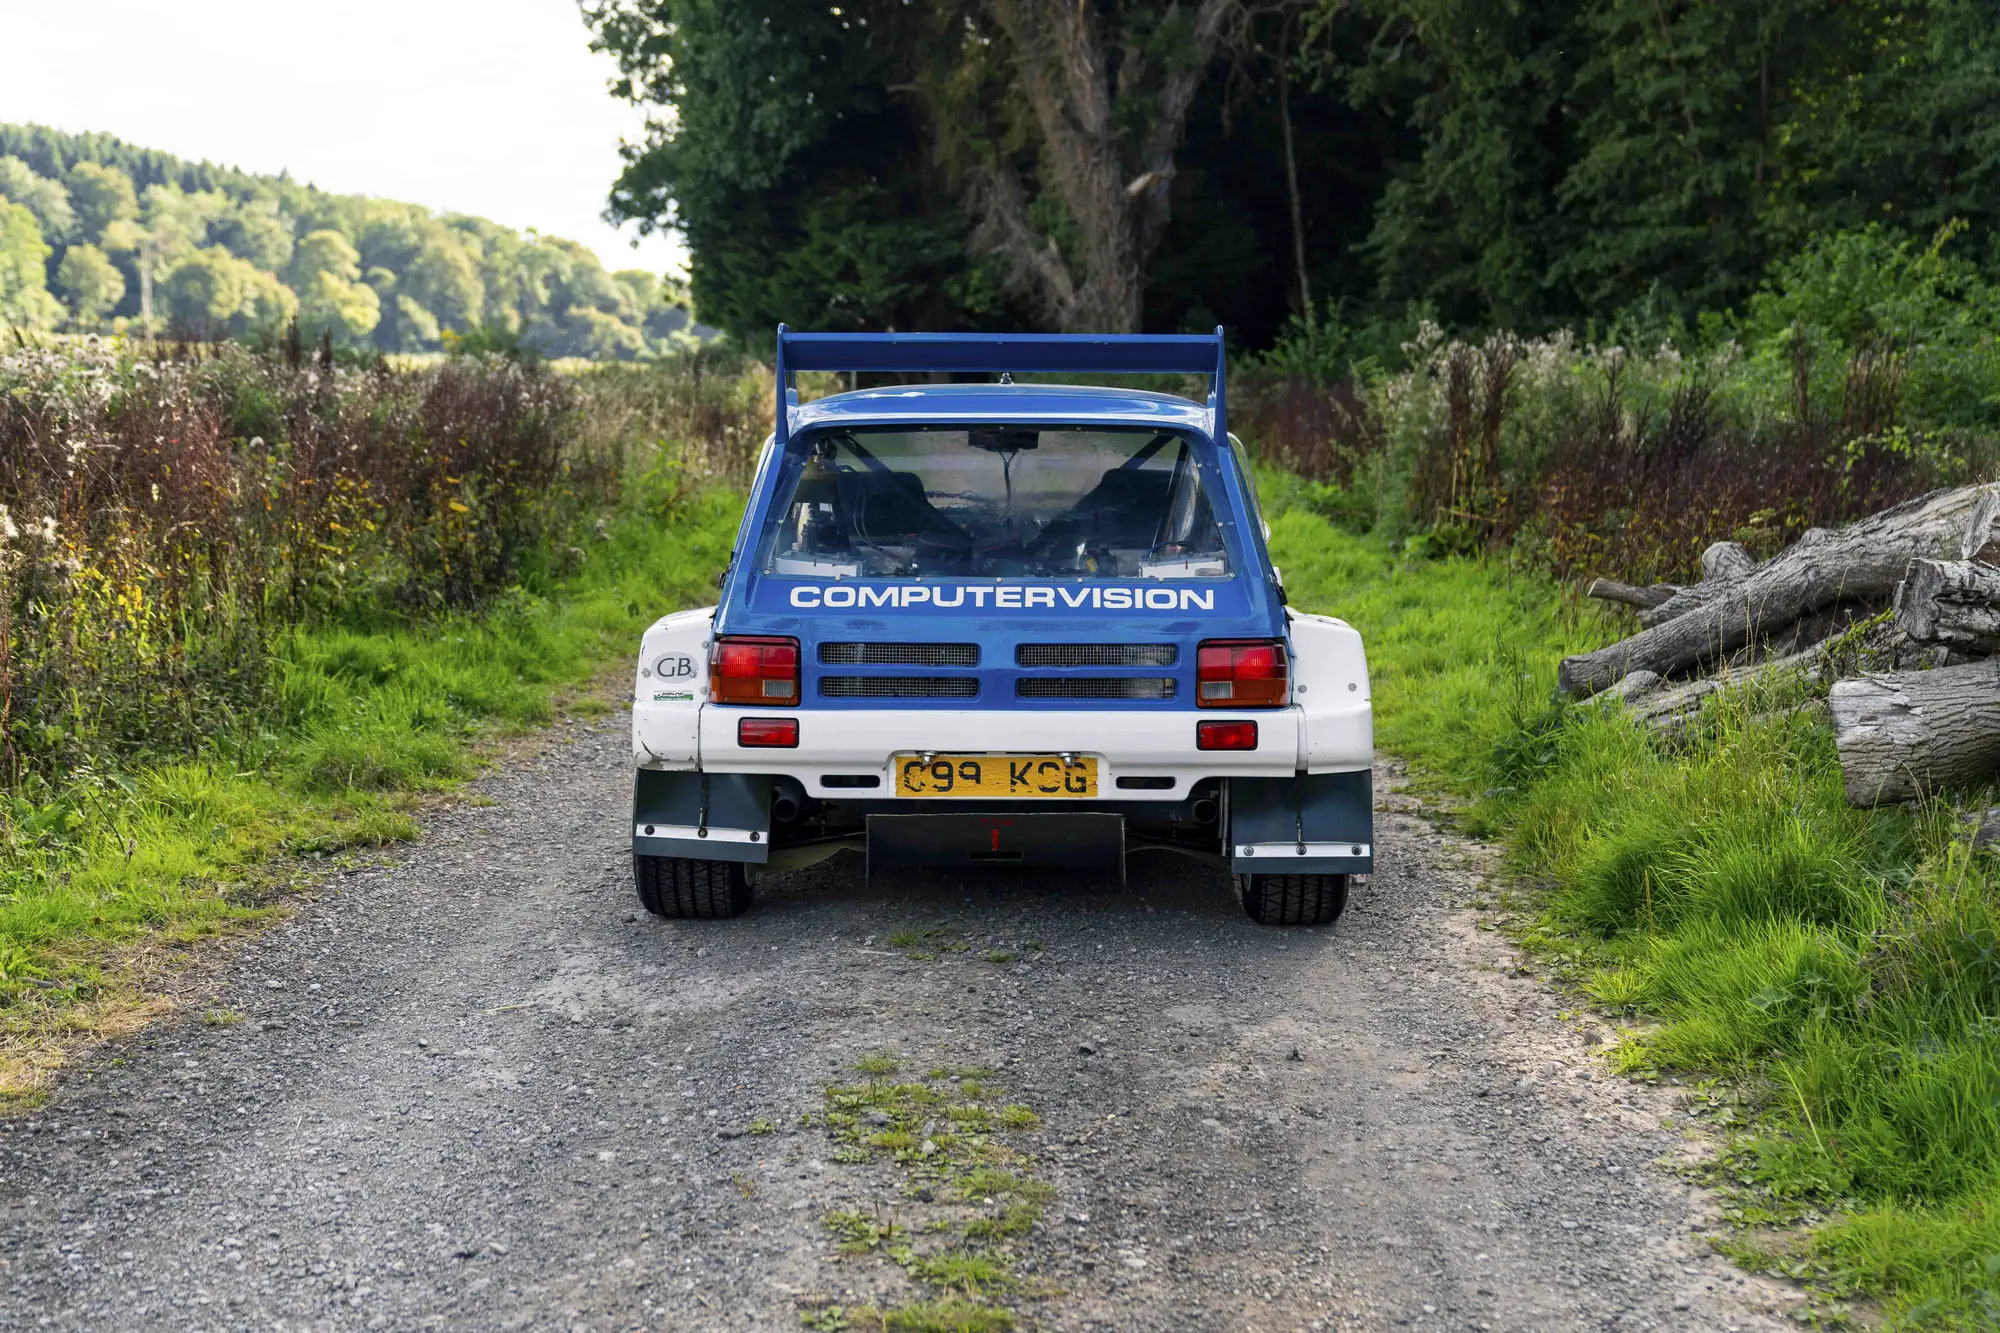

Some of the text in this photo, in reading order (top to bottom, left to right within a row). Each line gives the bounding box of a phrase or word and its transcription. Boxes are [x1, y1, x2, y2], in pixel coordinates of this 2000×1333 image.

[789, 586, 1215, 610] COMPUTERVISION
[657, 657, 692, 677] GB
[904, 761, 981, 792] C99
